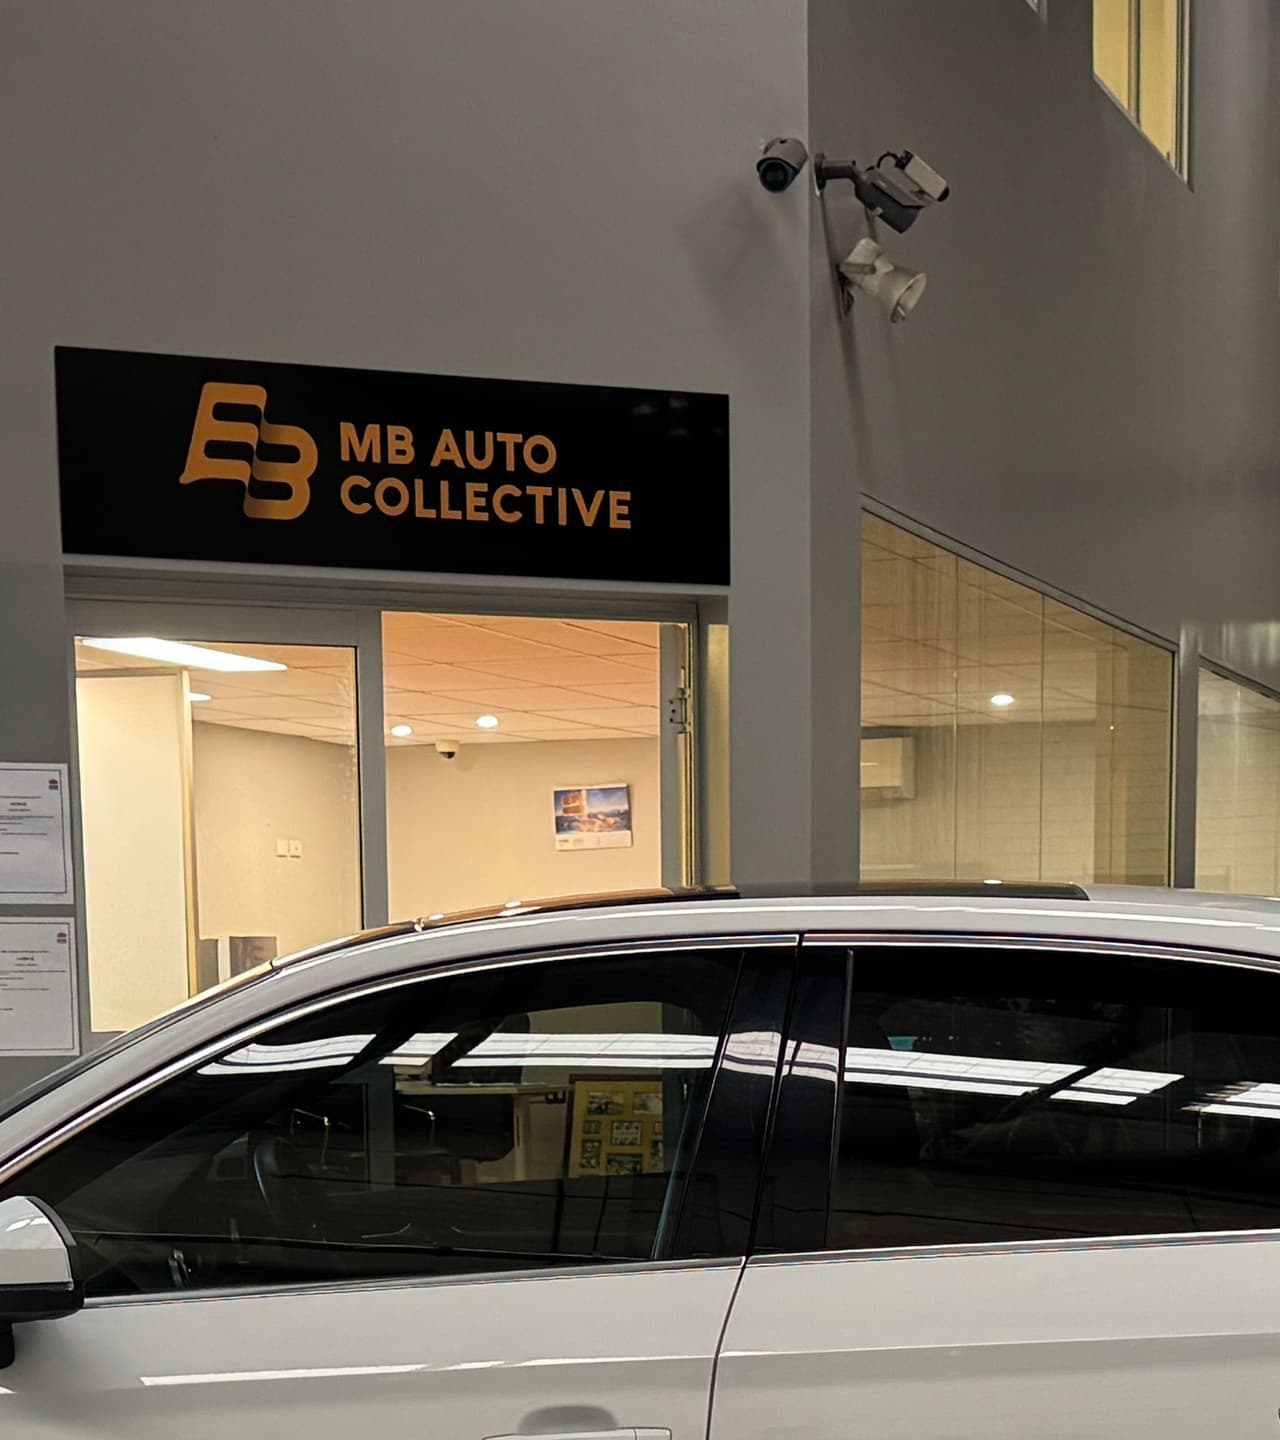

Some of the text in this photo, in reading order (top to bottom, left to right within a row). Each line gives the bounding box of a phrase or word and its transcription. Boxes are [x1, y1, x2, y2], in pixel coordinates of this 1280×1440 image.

[339, 421, 558, 474] MB AUTO
[339, 474, 632, 529] COLLECTIVE
